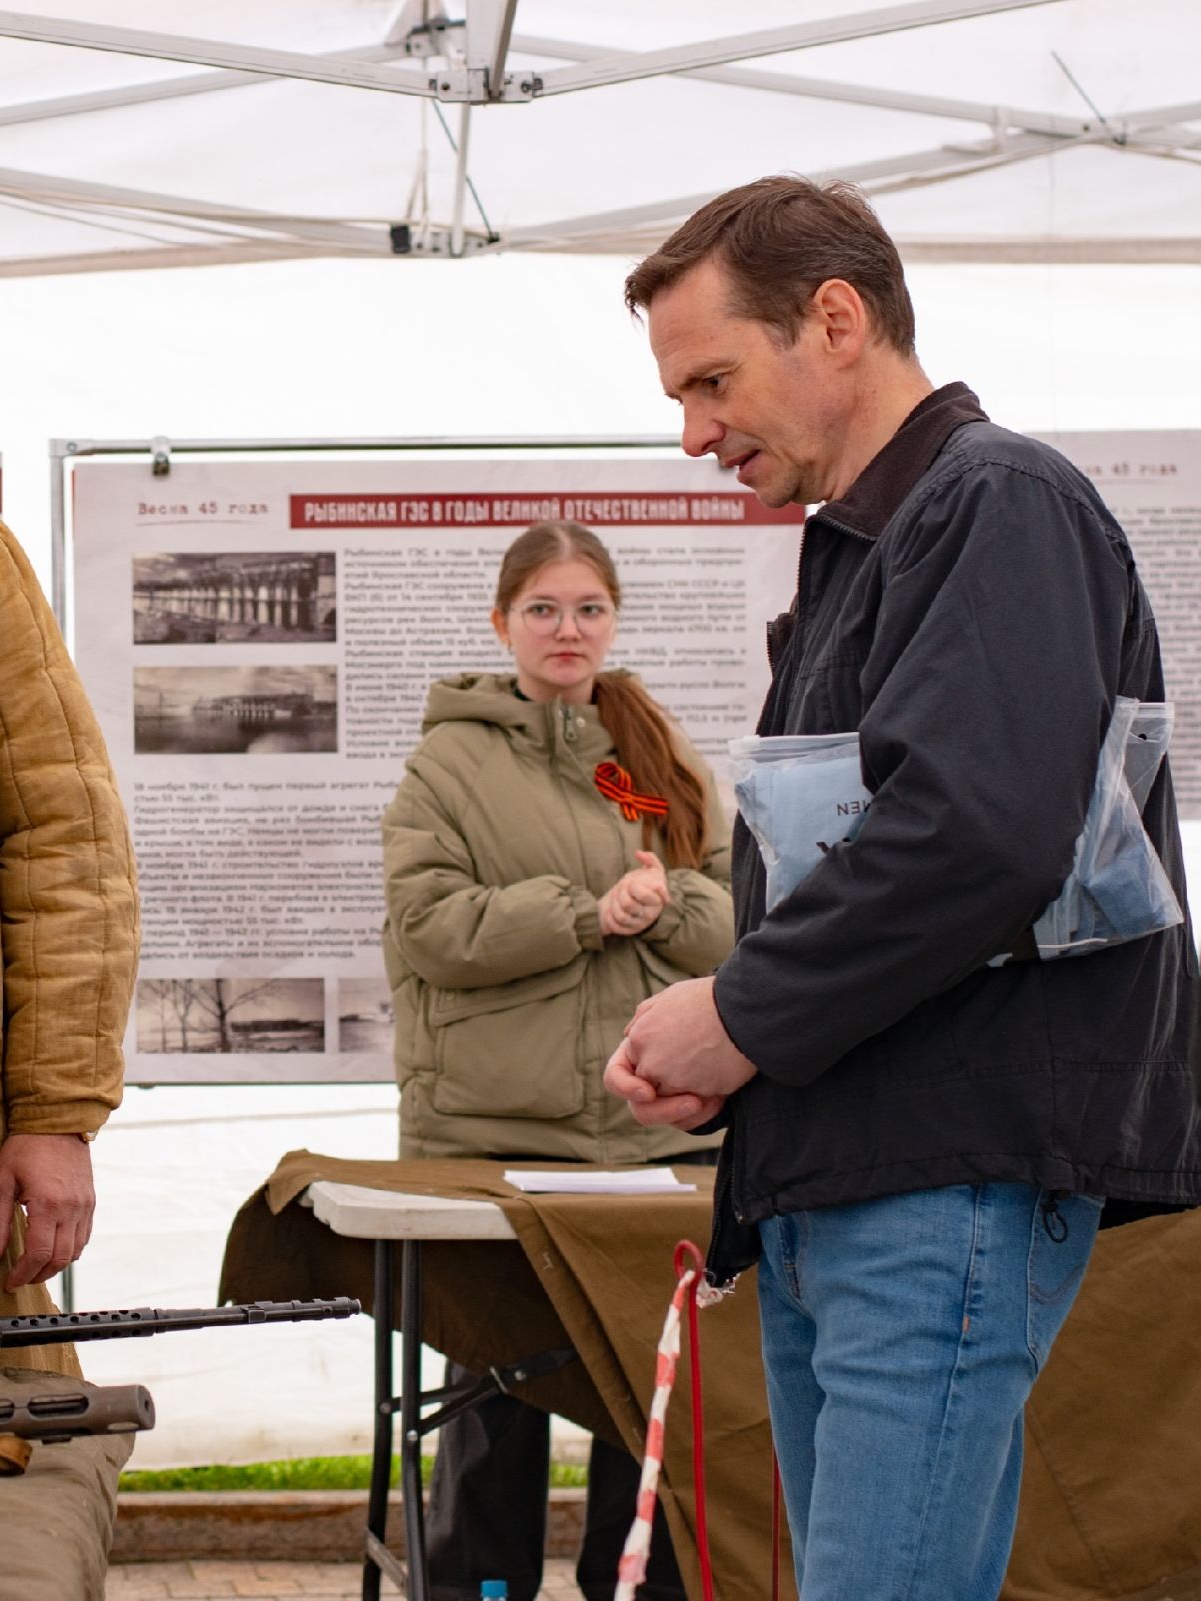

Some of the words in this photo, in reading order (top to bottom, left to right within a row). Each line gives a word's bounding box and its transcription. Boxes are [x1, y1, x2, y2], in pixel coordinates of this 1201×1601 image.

[138, 502, 189, 515] Весна
[198, 502, 217, 514] 45
[228, 502, 269, 515] года
[304, 501, 397, 522] РЫБИНСКАЯ
[401, 501, 429, 522] ГЭС
[432, 501, 441, 521] В
[445, 500, 489, 522] ГОДЫ
[493, 498, 560, 521] ВЕЛИКОЙ
[563, 497, 688, 521] ОТЕЧЕСТВЕННОЙ
[691, 496, 745, 520] ВОЙНЫ
